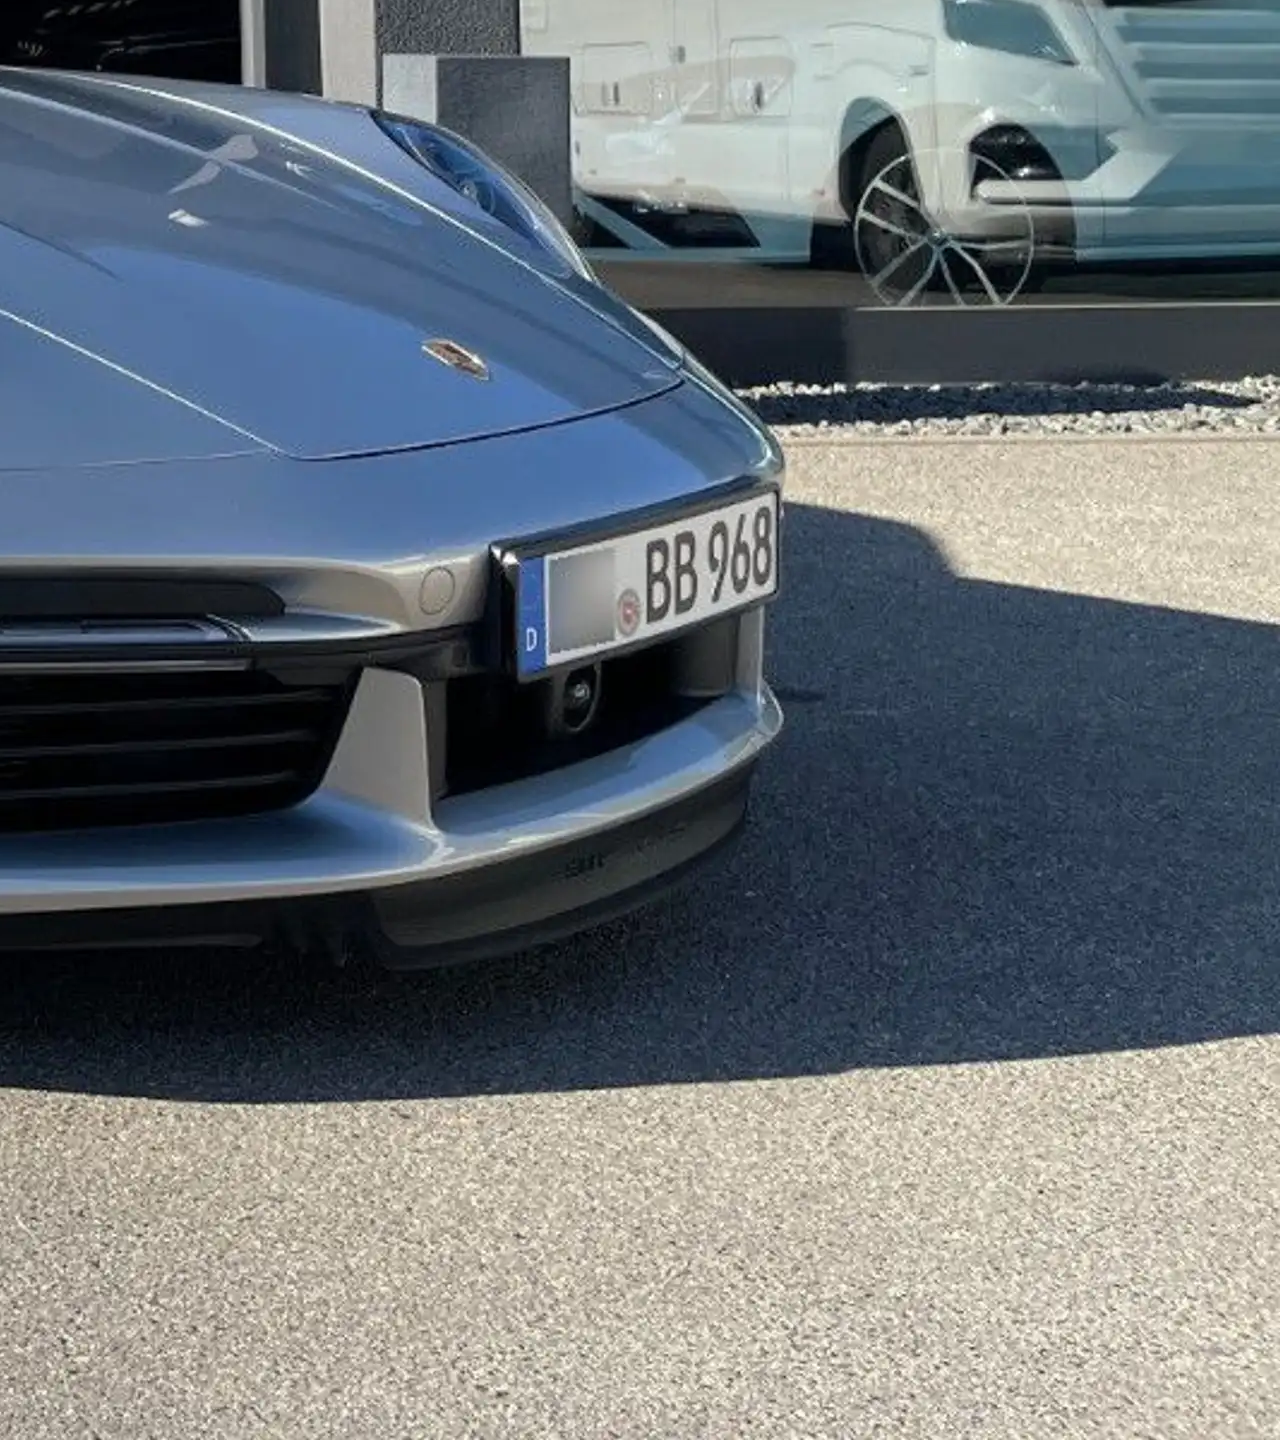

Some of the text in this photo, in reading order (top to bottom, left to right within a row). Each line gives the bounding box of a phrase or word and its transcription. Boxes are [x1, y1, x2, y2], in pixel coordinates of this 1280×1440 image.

[646, 506, 772, 623] BB 968
[525, 627, 538, 652] D
